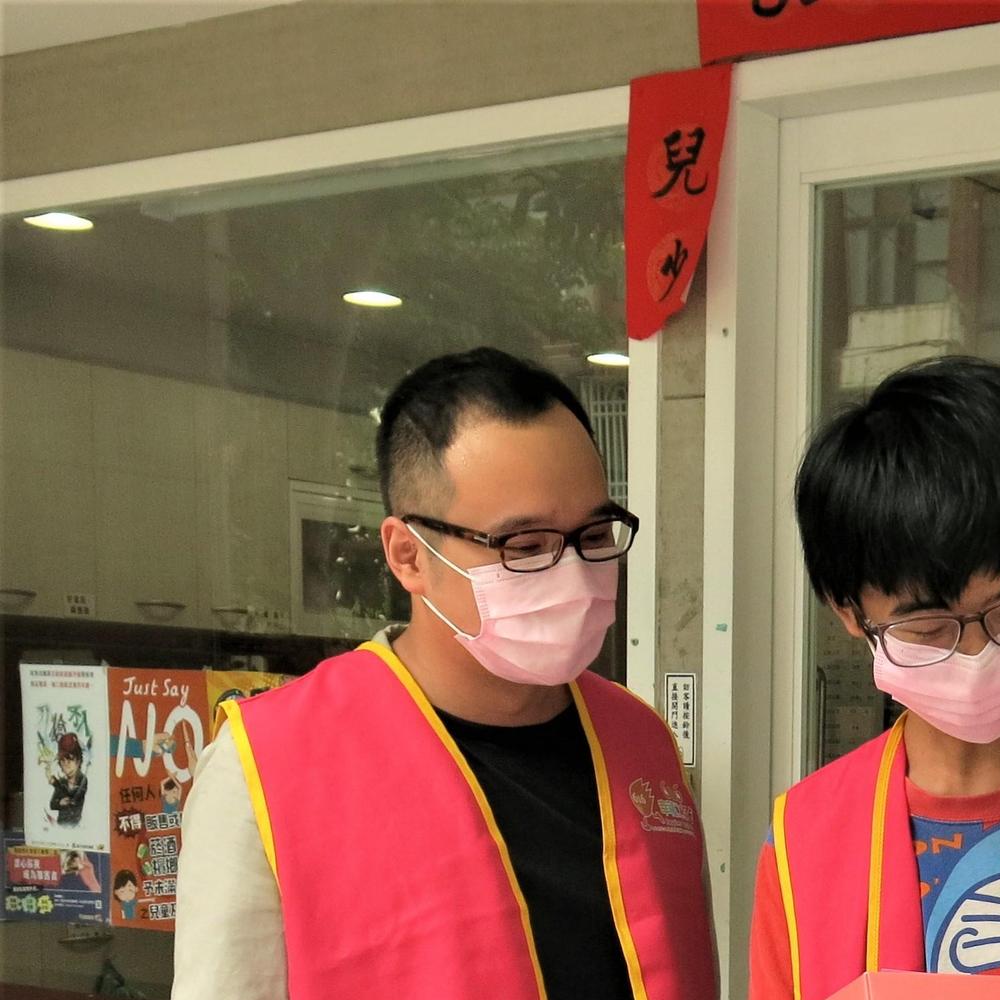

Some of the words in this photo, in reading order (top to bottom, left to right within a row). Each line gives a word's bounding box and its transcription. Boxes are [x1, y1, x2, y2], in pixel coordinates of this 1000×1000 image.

[122, 677, 158, 696] Just
[162, 679, 190, 704] Say
[145, 812, 182, 831] 販售或
